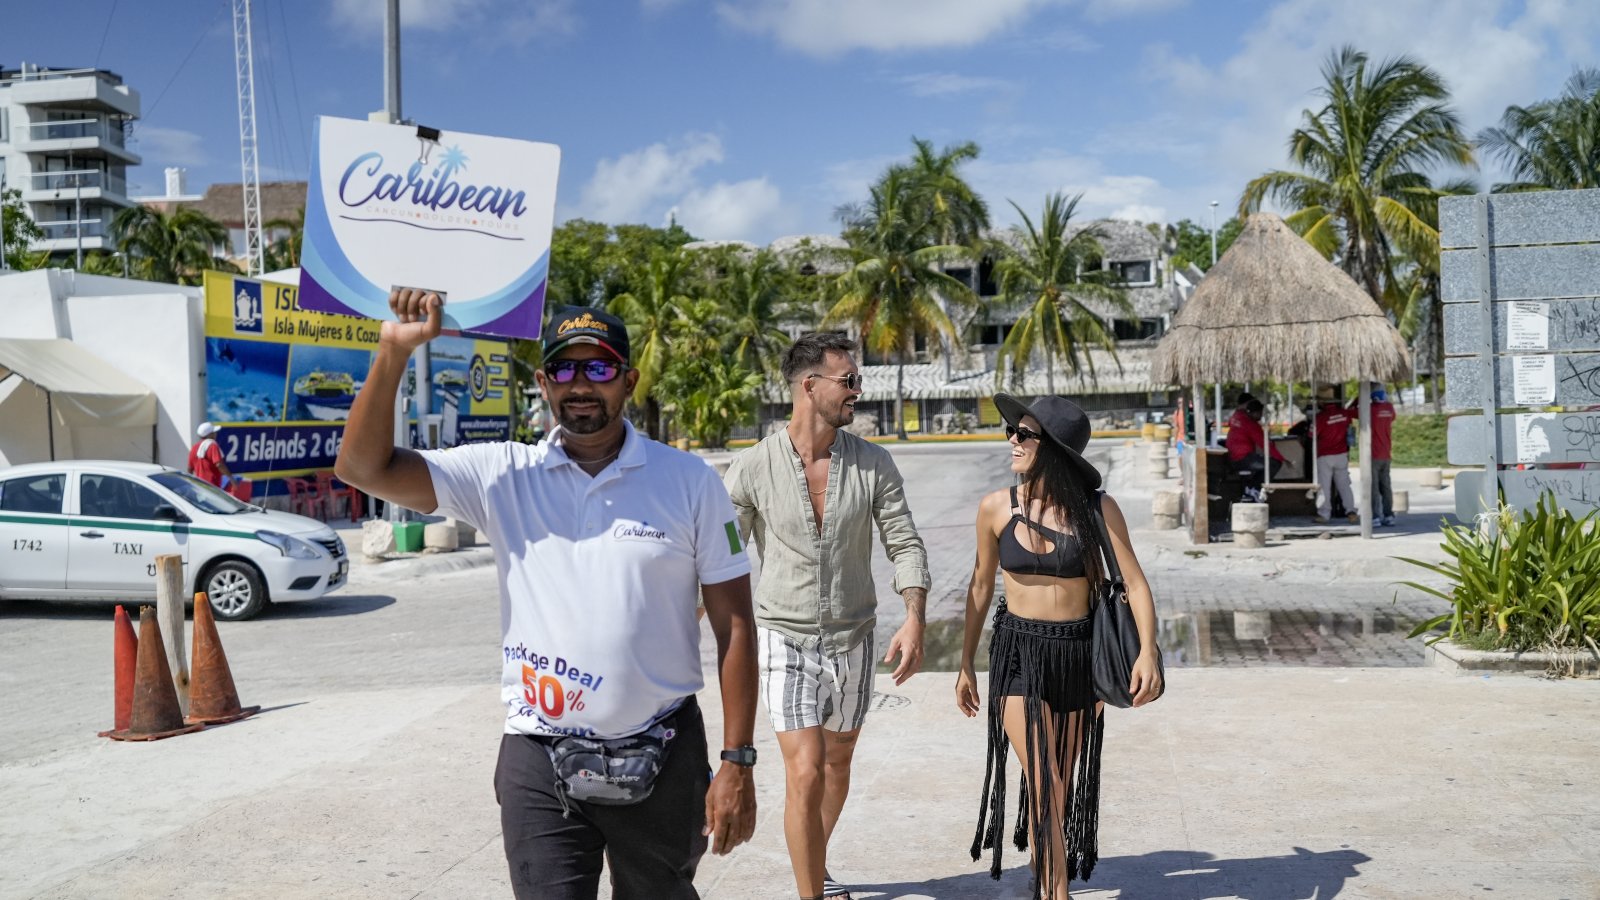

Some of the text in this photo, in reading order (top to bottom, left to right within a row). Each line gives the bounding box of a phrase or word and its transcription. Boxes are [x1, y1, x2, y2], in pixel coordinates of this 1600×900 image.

[339, 152, 527, 219] Caribean
[366, 205, 520, 231] CANCUN GOLDEN TOURS
[274, 317, 380, 343] Isla Mujeres & Cozu
[225, 430, 344, 462] 2 Islands 2 da
[13, 539, 143, 555] 1742 TAXI
[504, 642, 603, 692] Packge Deal
